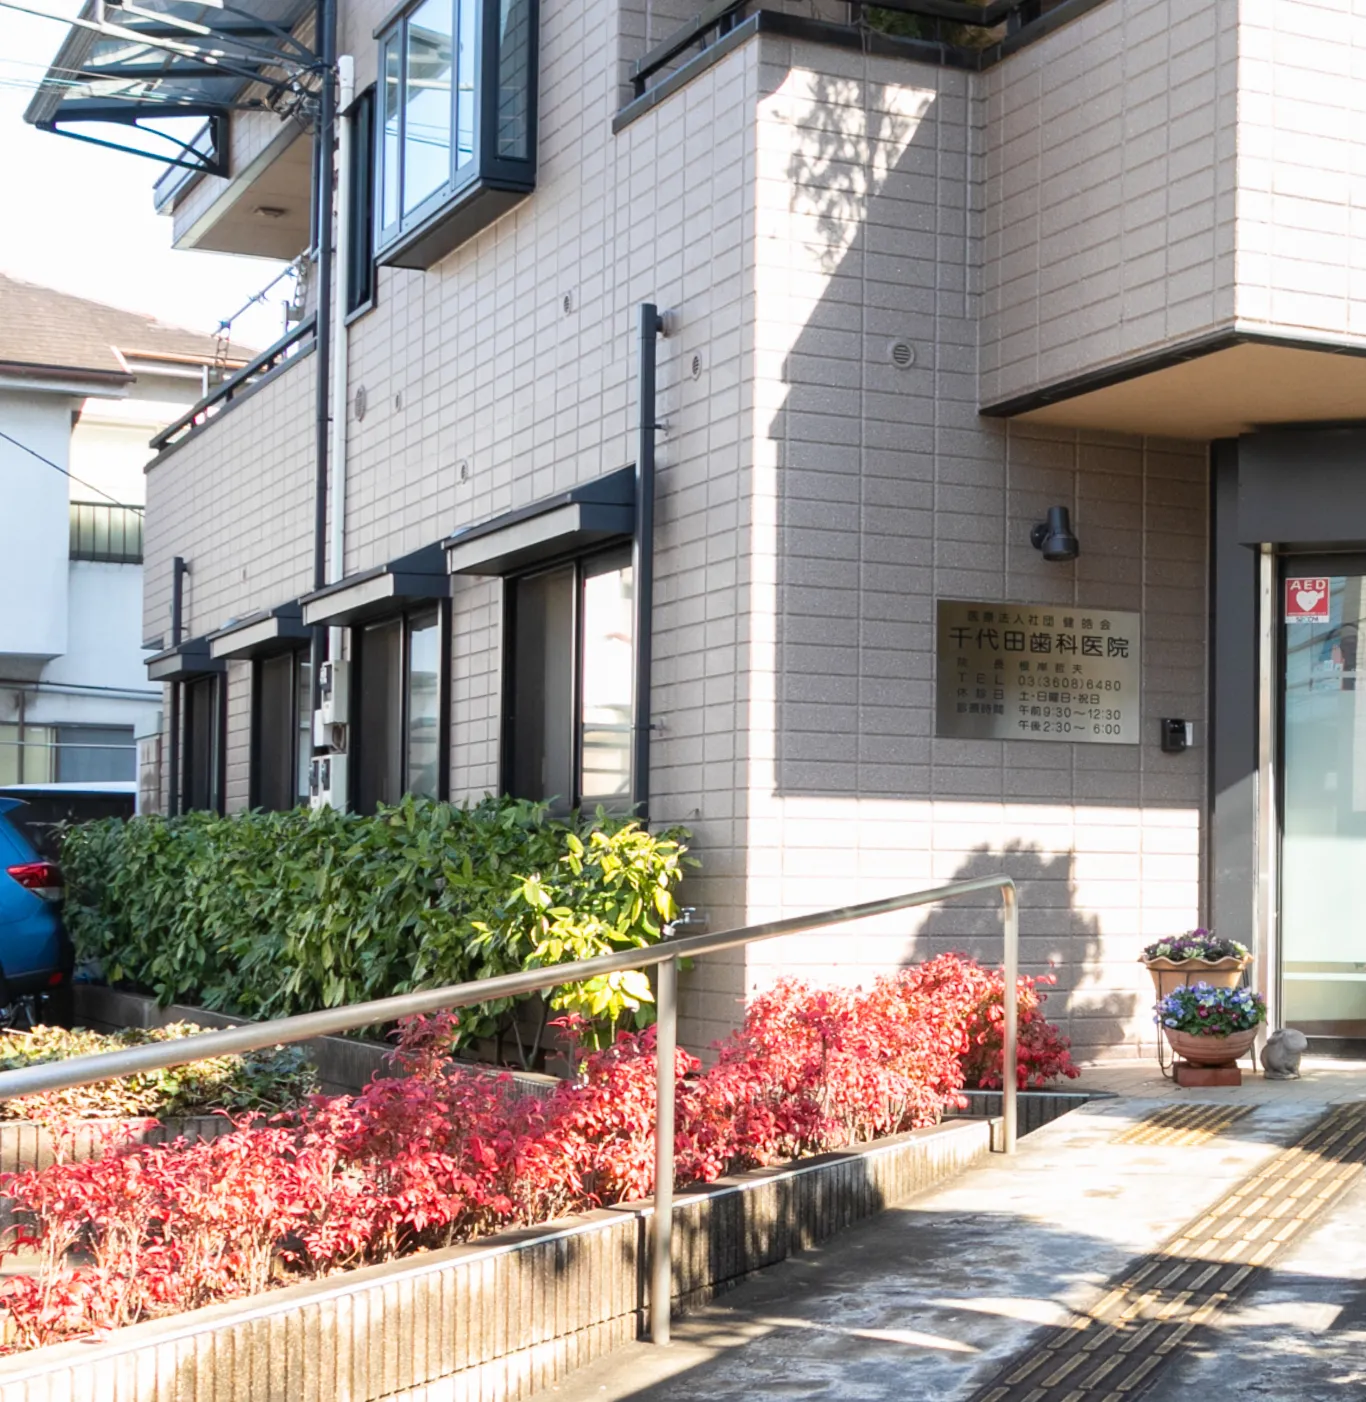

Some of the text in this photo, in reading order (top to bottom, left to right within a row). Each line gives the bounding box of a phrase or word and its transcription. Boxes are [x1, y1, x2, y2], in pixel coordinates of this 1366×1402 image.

[1290, 579, 1326, 590] AED
[948, 627, 1129, 659] 千代田歯科医院
[1018, 675, 1121, 692] 03(3608)6480
